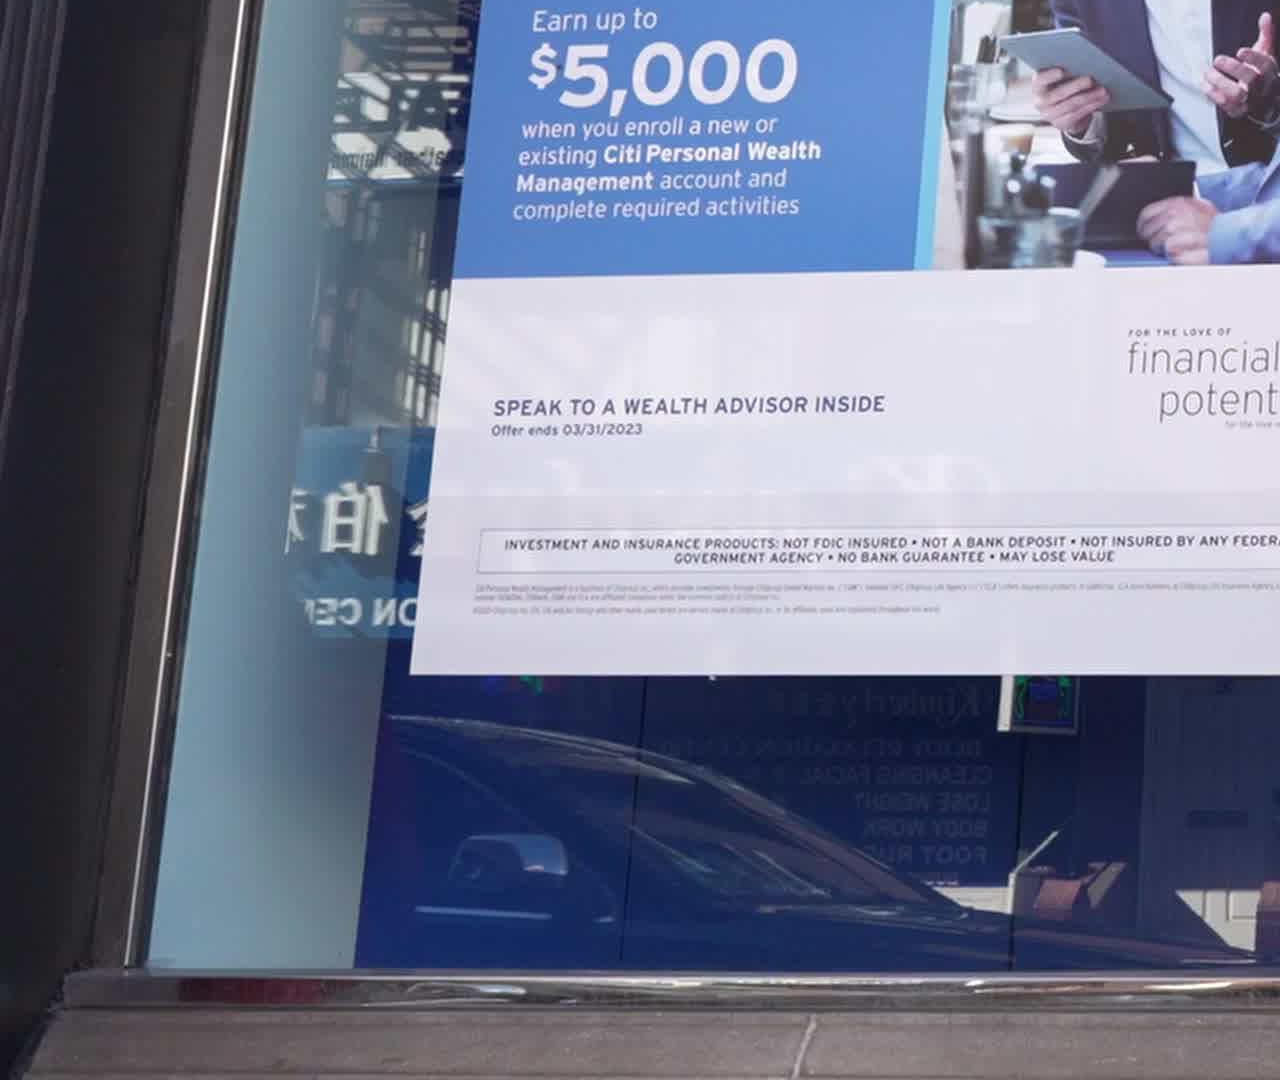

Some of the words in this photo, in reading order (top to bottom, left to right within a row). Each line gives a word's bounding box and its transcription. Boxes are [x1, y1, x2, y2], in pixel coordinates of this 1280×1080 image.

[533, 10, 587, 32] Earn
[596, 13, 625, 34] up
[634, 8, 657, 29] to
[529, 39, 797, 117] $5,000
[522, 121, 575, 138] when
[583, 122, 618, 140] you
[625, 117, 683, 136] enroll
[689, 120, 701, 135] a
[708, 120, 749, 134] new
[756, 118, 778, 133] or
[519, 146, 597, 168] existing
[604, 144, 641, 163] Citi
[646, 143, 739, 163] Personal
[747, 141, 822, 162] Wealth
[517, 171, 653, 195] Management
[660, 169, 742, 189] account
[748, 168, 786, 187] and
[513, 200, 607, 222] complete
[614, 198, 700, 220] required
[706, 196, 798, 216] activities
[1184, 328, 1211, 336] LOVE
[1217, 328, 1231, 336] OF
[1128, 341, 1279, 374] financial
[494, 400, 561, 416] SPEAK
[570, 399, 595, 415] TO
[602, 400, 615, 414] A
[624, 398, 707, 415] WEALTH
[714, 397, 808, 414] ADVISOR
[816, 396, 884, 412] INSIDE
[492, 424, 524, 436] Offer
[528, 425, 558, 436] ends
[563, 423, 642, 436] 03/31/2023
[505, 539, 587, 550] INVESTMENT
[592, 539, 620, 549] AND
[624, 539, 699, 549] INSURANCE
[705, 538, 780, 549] PRODUCTS:
[783, 538, 808, 548] NOT
[814, 537, 843, 549] FDIC
[848, 537, 907, 548] INSURED
[922, 537, 947, 548] NOT
[953, 538, 961, 547] A
[967, 538, 1003, 548] BANK
[1008, 536, 1065, 548] DEPOSIT
[1081, 536, 1107, 547] NOT
[1112, 536, 1172, 547] INSURED
[1177, 536, 1194, 547] BY
[1200, 536, 1228, 546] ANY
[674, 552, 764, 564] GOVERNMENT
[770, 552, 823, 563] AGENCY
[838, 552, 856, 563] NO
[861, 552, 898, 562] BANK
[903, 551, 984, 562] GUARANTEE
[1000, 552, 1028, 561] MAY
[1032, 551, 1066, 562] LOSE
[1072, 551, 1114, 562] VALUE
